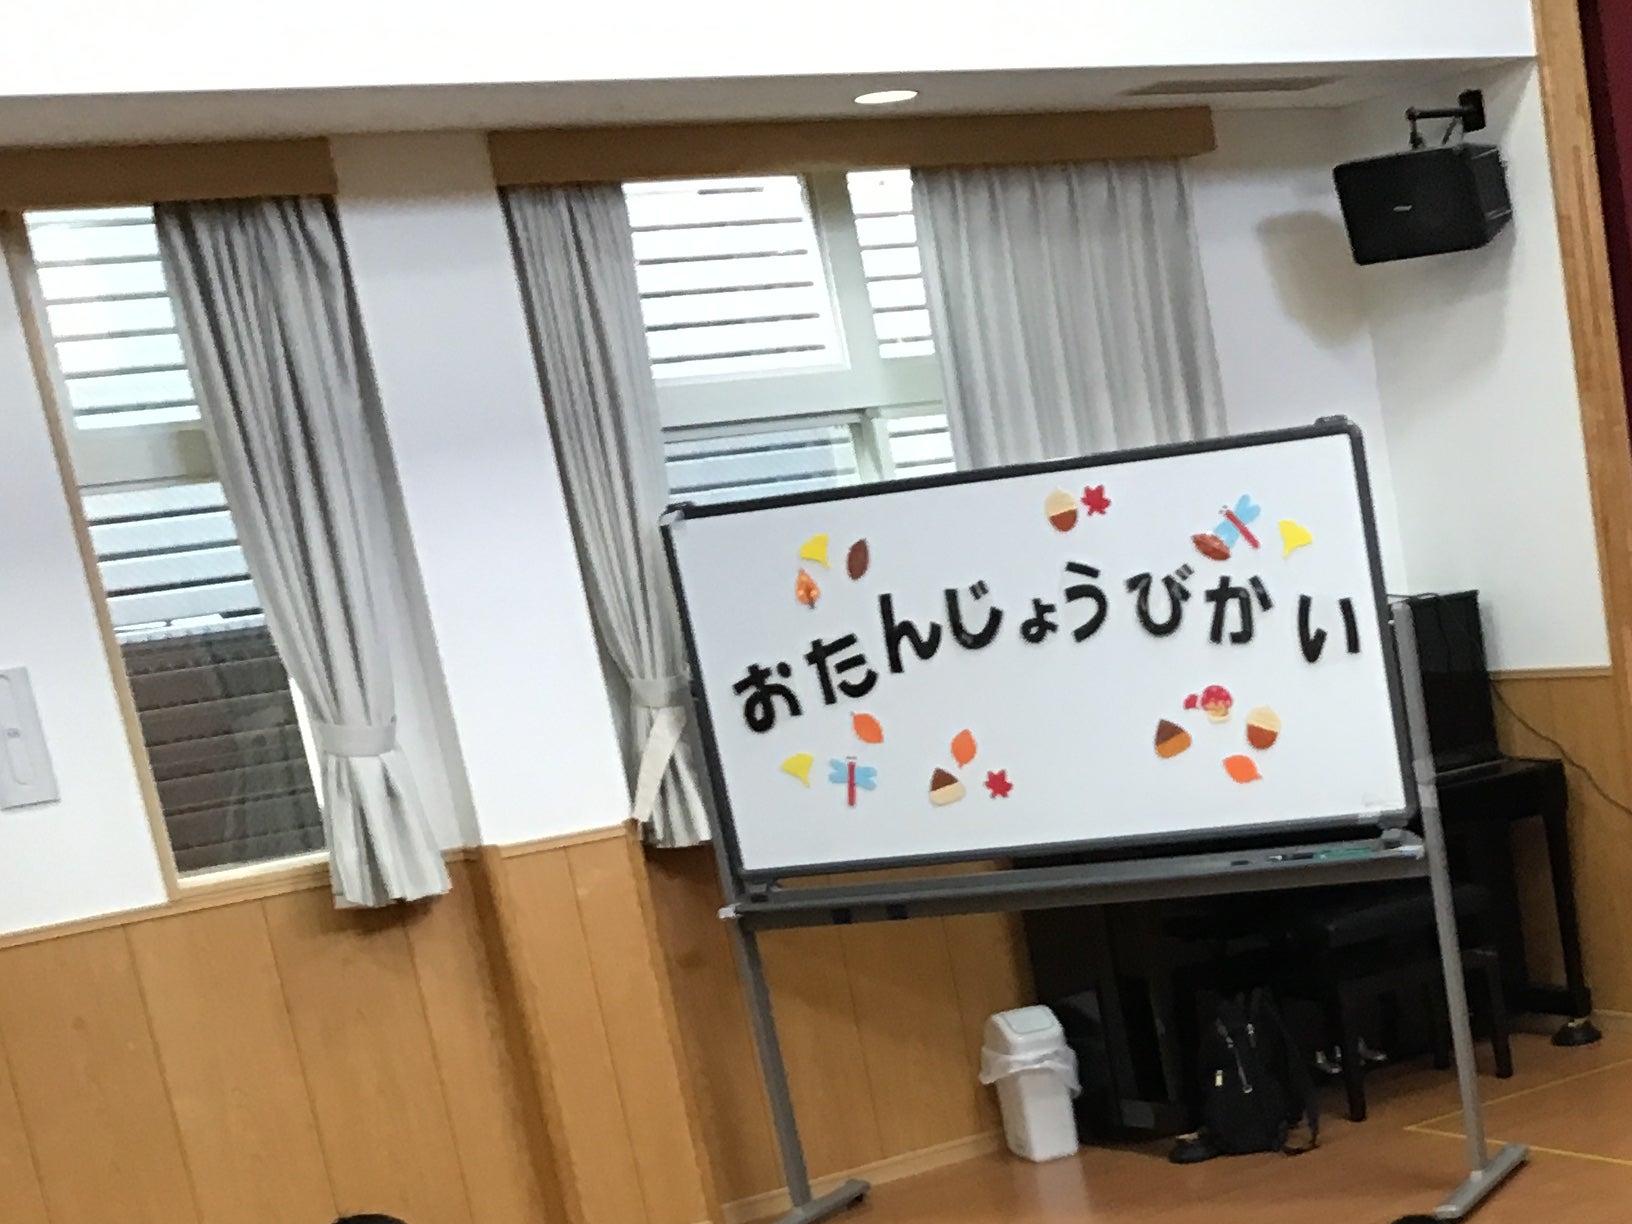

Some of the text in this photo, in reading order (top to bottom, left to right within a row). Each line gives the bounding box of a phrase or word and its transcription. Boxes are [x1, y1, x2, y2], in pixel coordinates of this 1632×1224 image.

[732, 560, 1362, 735] おたんじょうびかい
